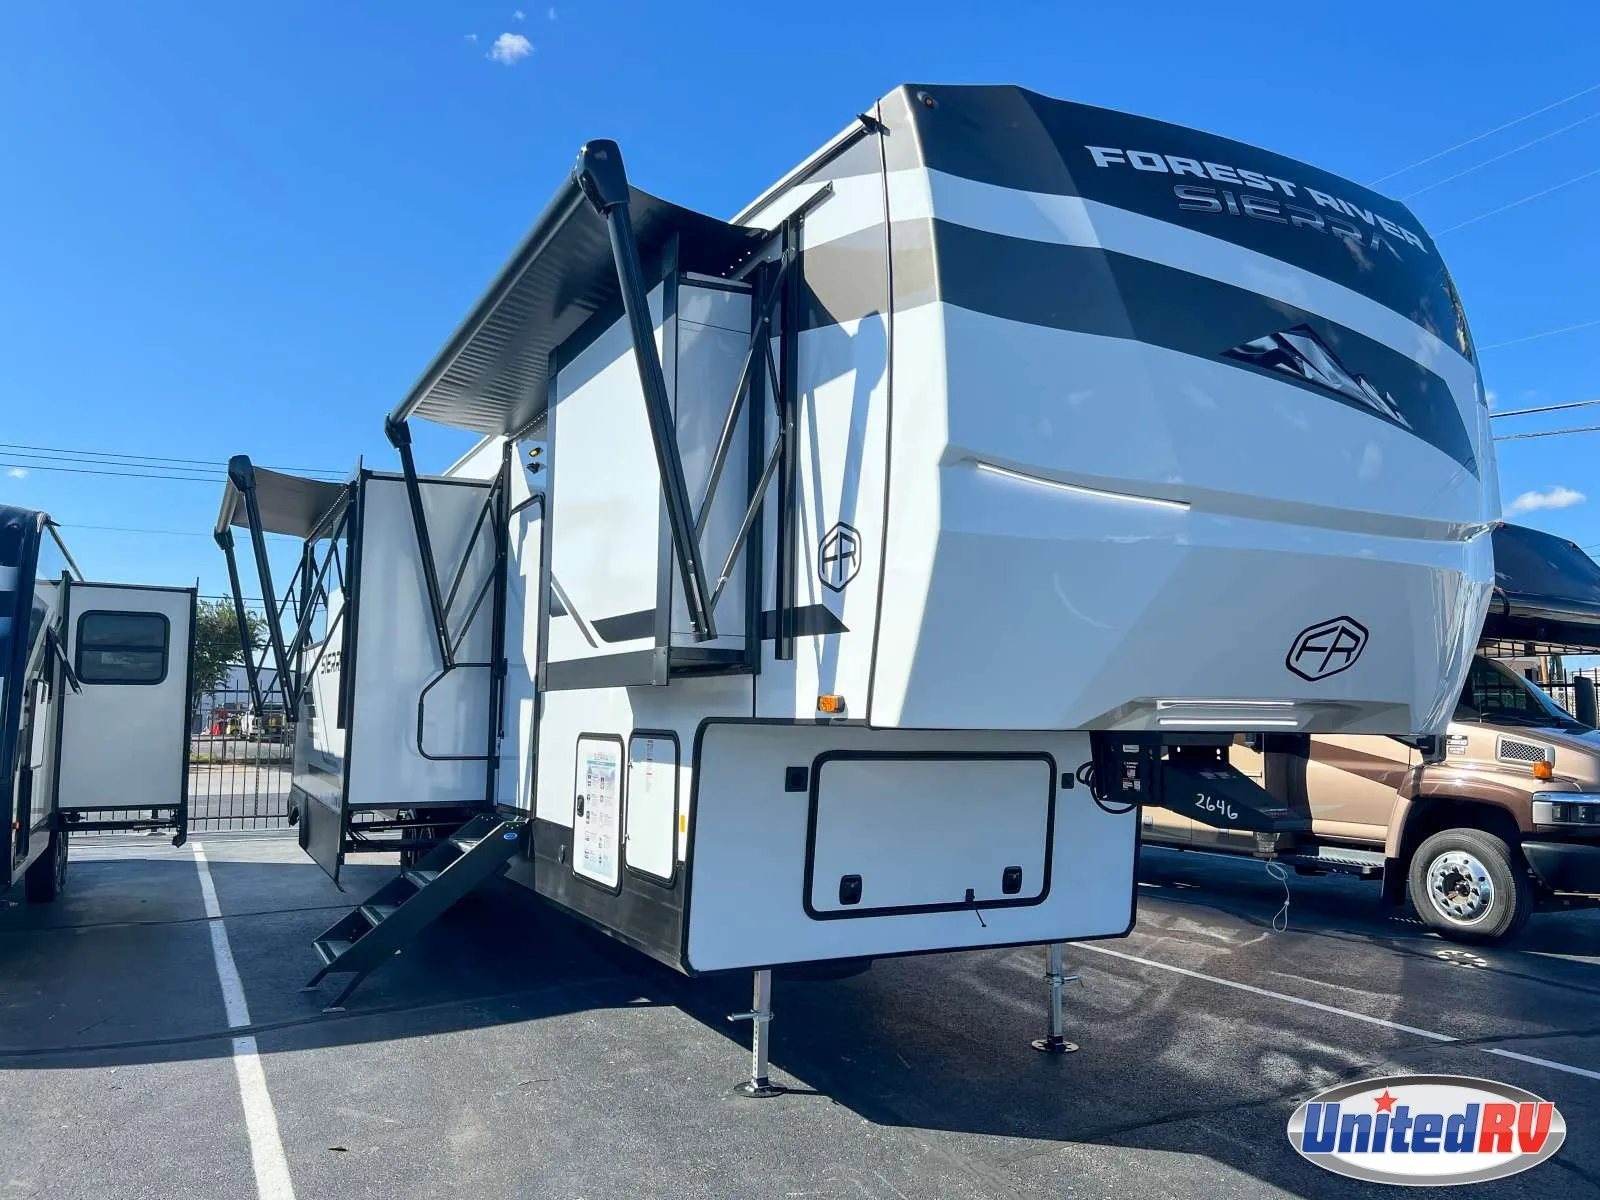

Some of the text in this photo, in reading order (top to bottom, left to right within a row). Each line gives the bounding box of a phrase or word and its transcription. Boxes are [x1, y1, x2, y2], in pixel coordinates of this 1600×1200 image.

[1084, 145, 1428, 254] FOREST RIVER
[1173, 184, 1404, 262] SIERRA
[321, 651, 341, 674] SIERR
[1195, 793, 1238, 820] 2646
